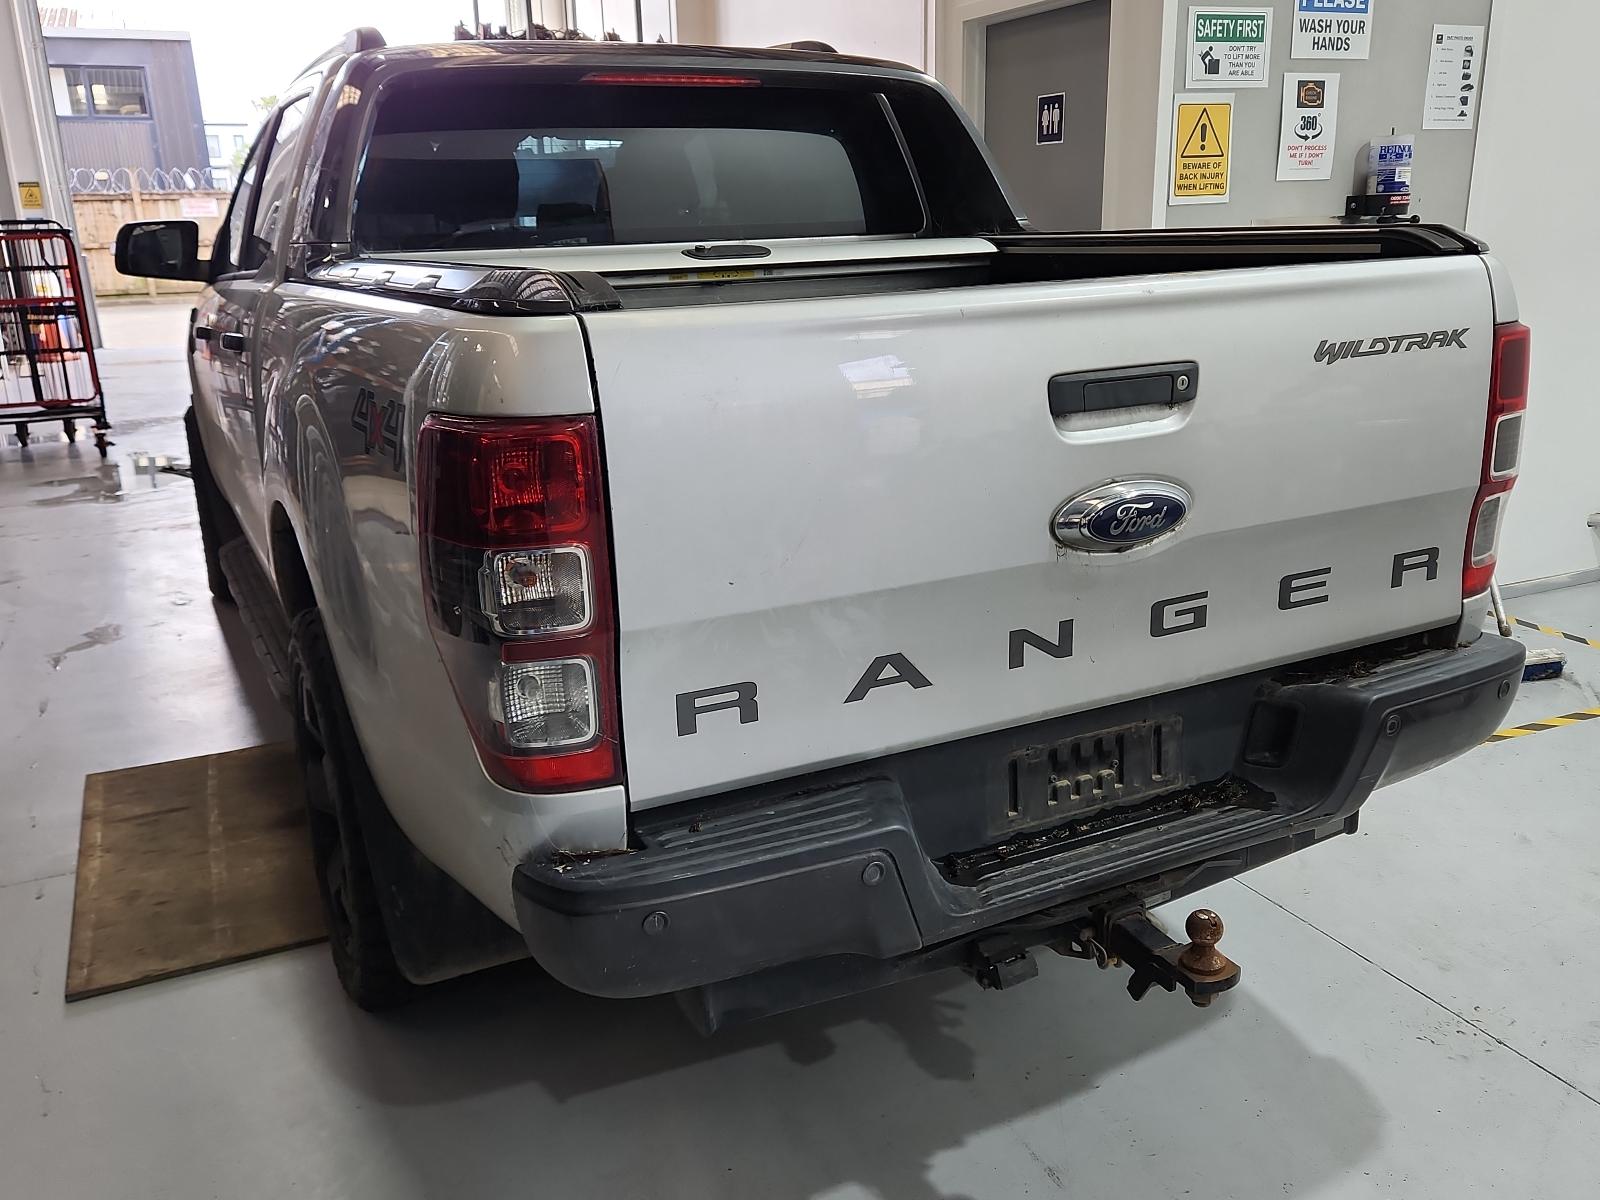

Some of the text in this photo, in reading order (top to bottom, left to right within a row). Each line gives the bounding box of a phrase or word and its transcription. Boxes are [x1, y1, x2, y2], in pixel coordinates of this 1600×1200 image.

[1197, 19, 1264, 38] SAFETY FIRST
[1299, 18, 1366, 35] WASH YOUR
[1246, 45, 1257, 53] TRY
[1312, 36, 1351, 52] HANDS
[1182, 161, 1222, 170] BEWARE OF
[1179, 172, 1225, 181] BACK INJURY
[1176, 182, 1225, 191] WHEN LIFTING
[1313, 327, 1471, 366] WILDTRAK
[1109, 501, 1168, 536] Ford
[676, 546, 1440, 737] RANGER
